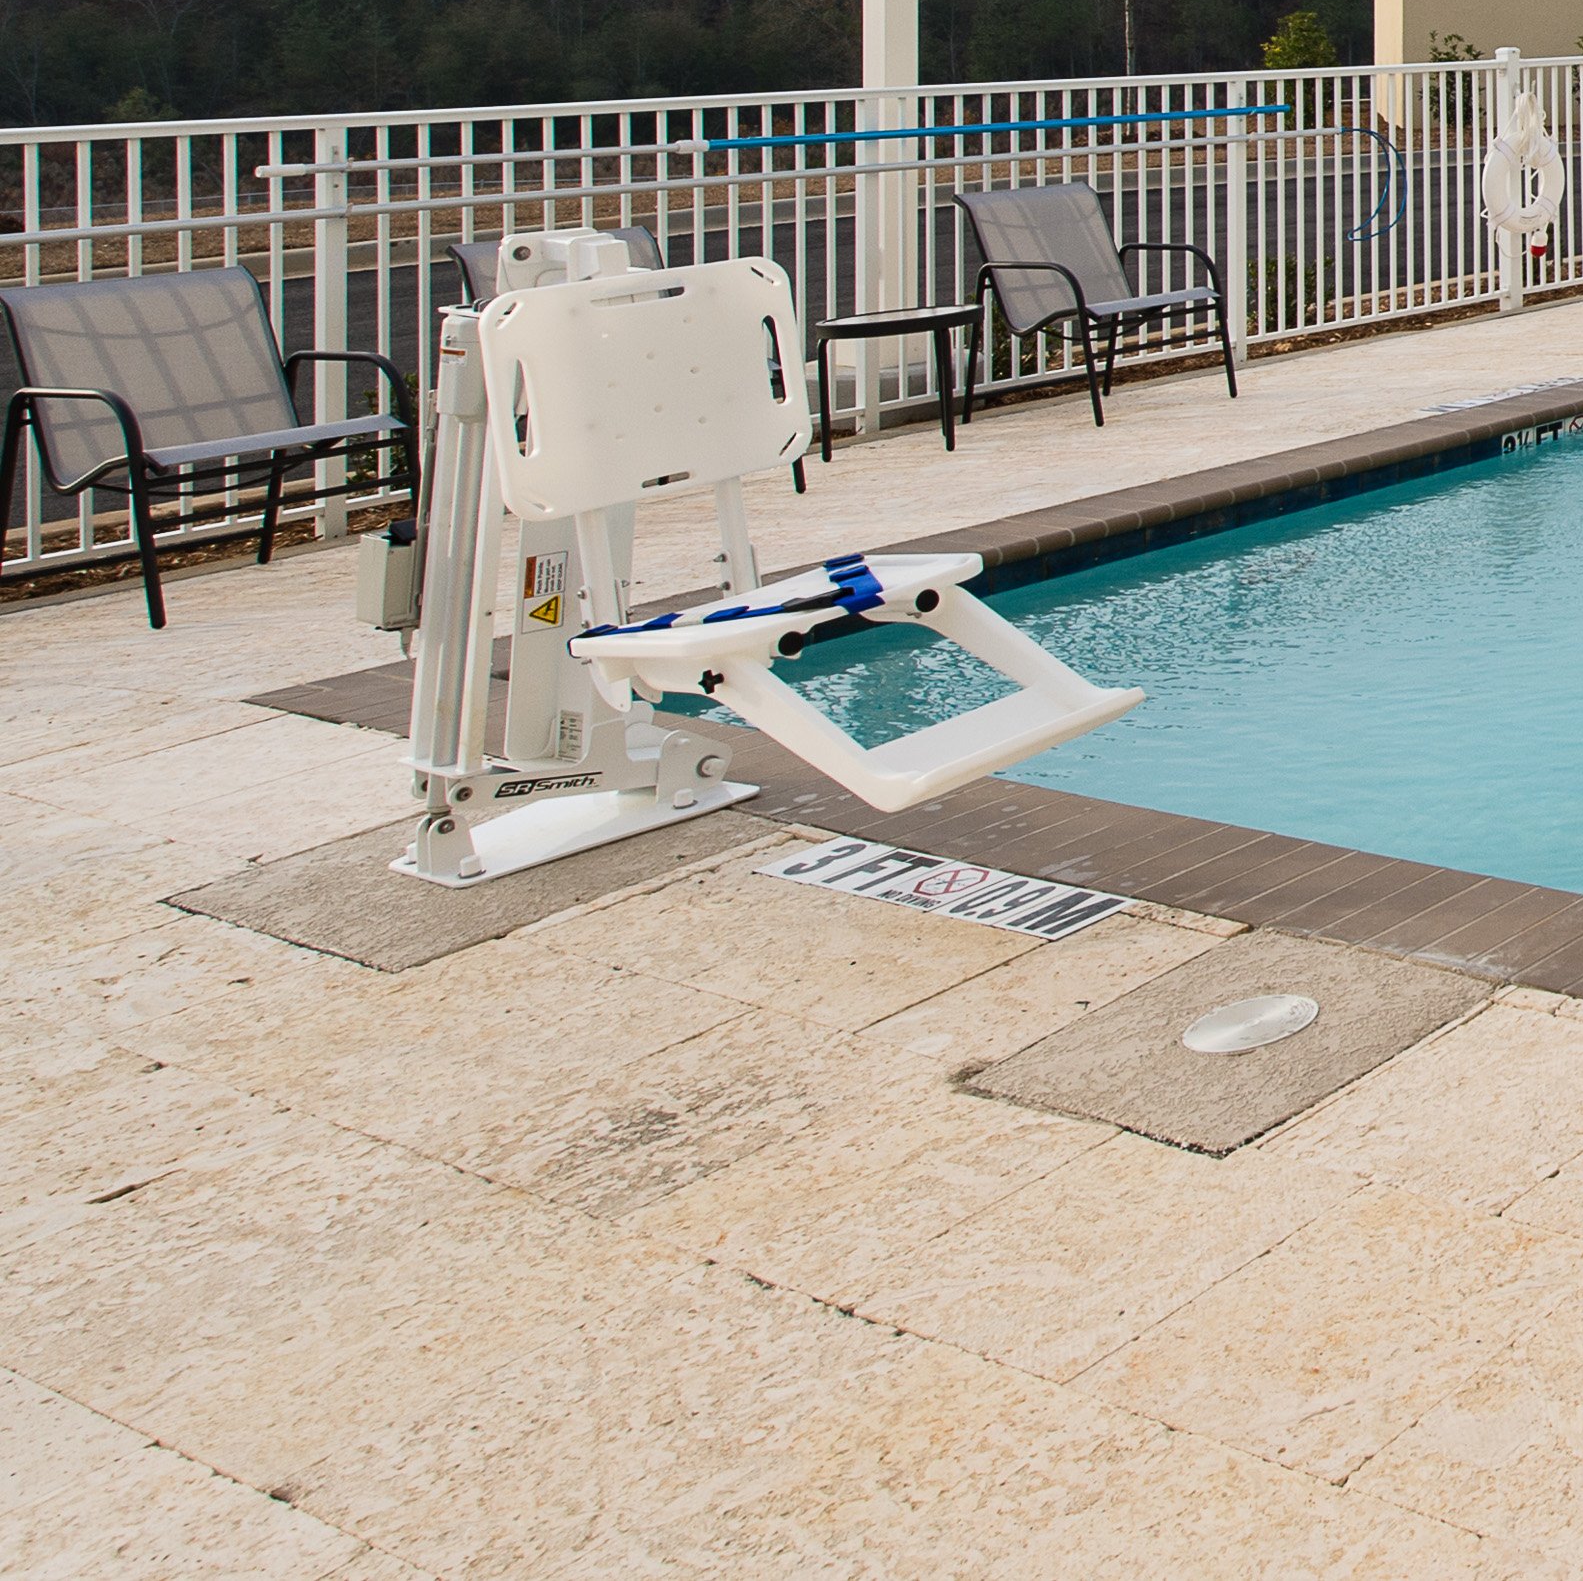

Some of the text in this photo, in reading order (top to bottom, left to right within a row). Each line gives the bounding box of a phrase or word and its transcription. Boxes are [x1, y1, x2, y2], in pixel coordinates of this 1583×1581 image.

[499, 776, 595, 796] SR Smith
[783, 843, 1118, 936] 3 FT 0.9 M
